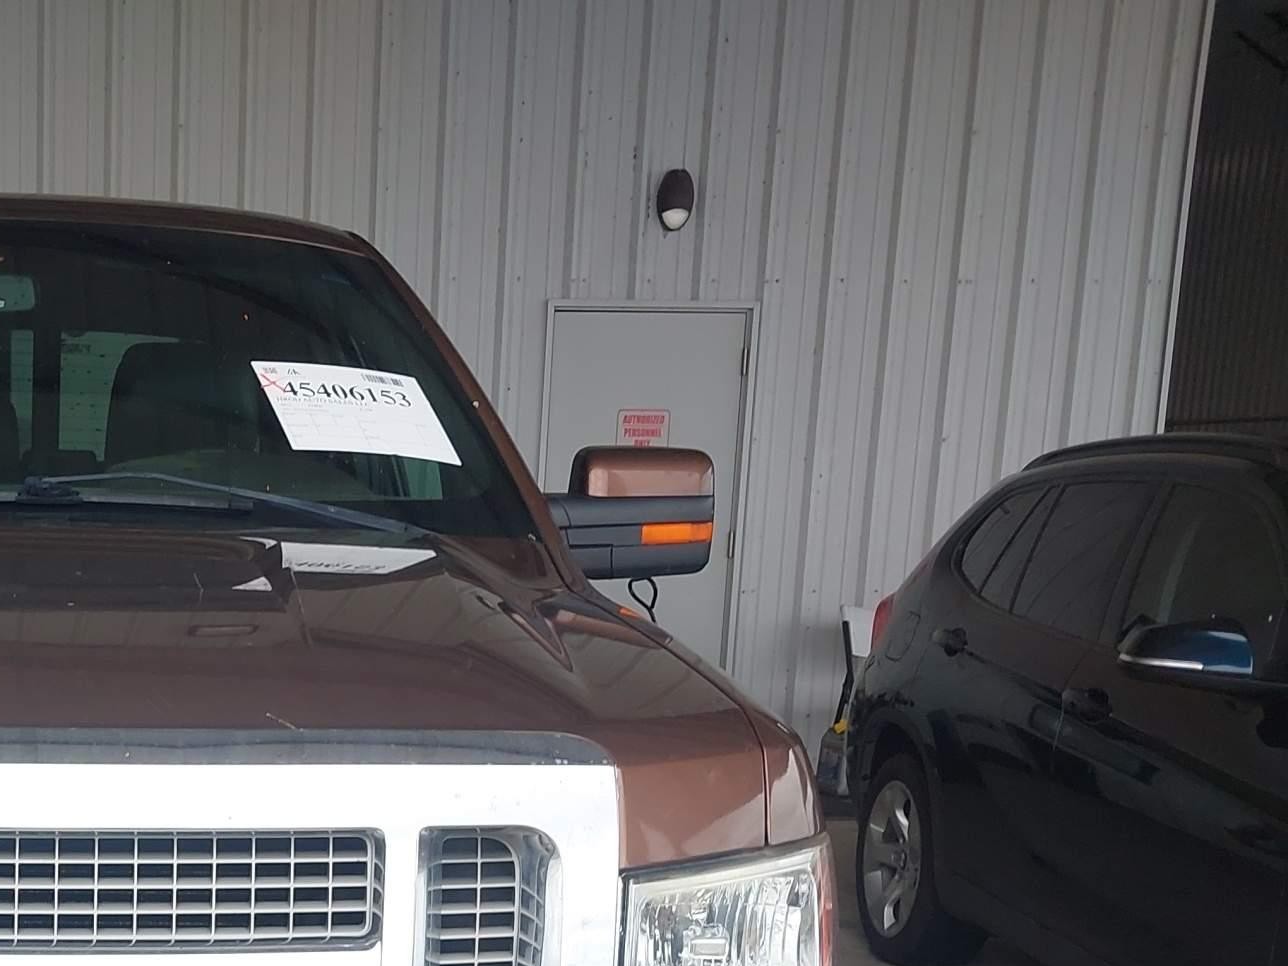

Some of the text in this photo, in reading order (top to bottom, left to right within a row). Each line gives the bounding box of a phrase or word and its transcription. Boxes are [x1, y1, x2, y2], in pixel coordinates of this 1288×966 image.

[283, 381, 412, 408] 45406153
[623, 415, 665, 424] AUTHORIZED
[623, 428, 662, 437] PERSONNEL
